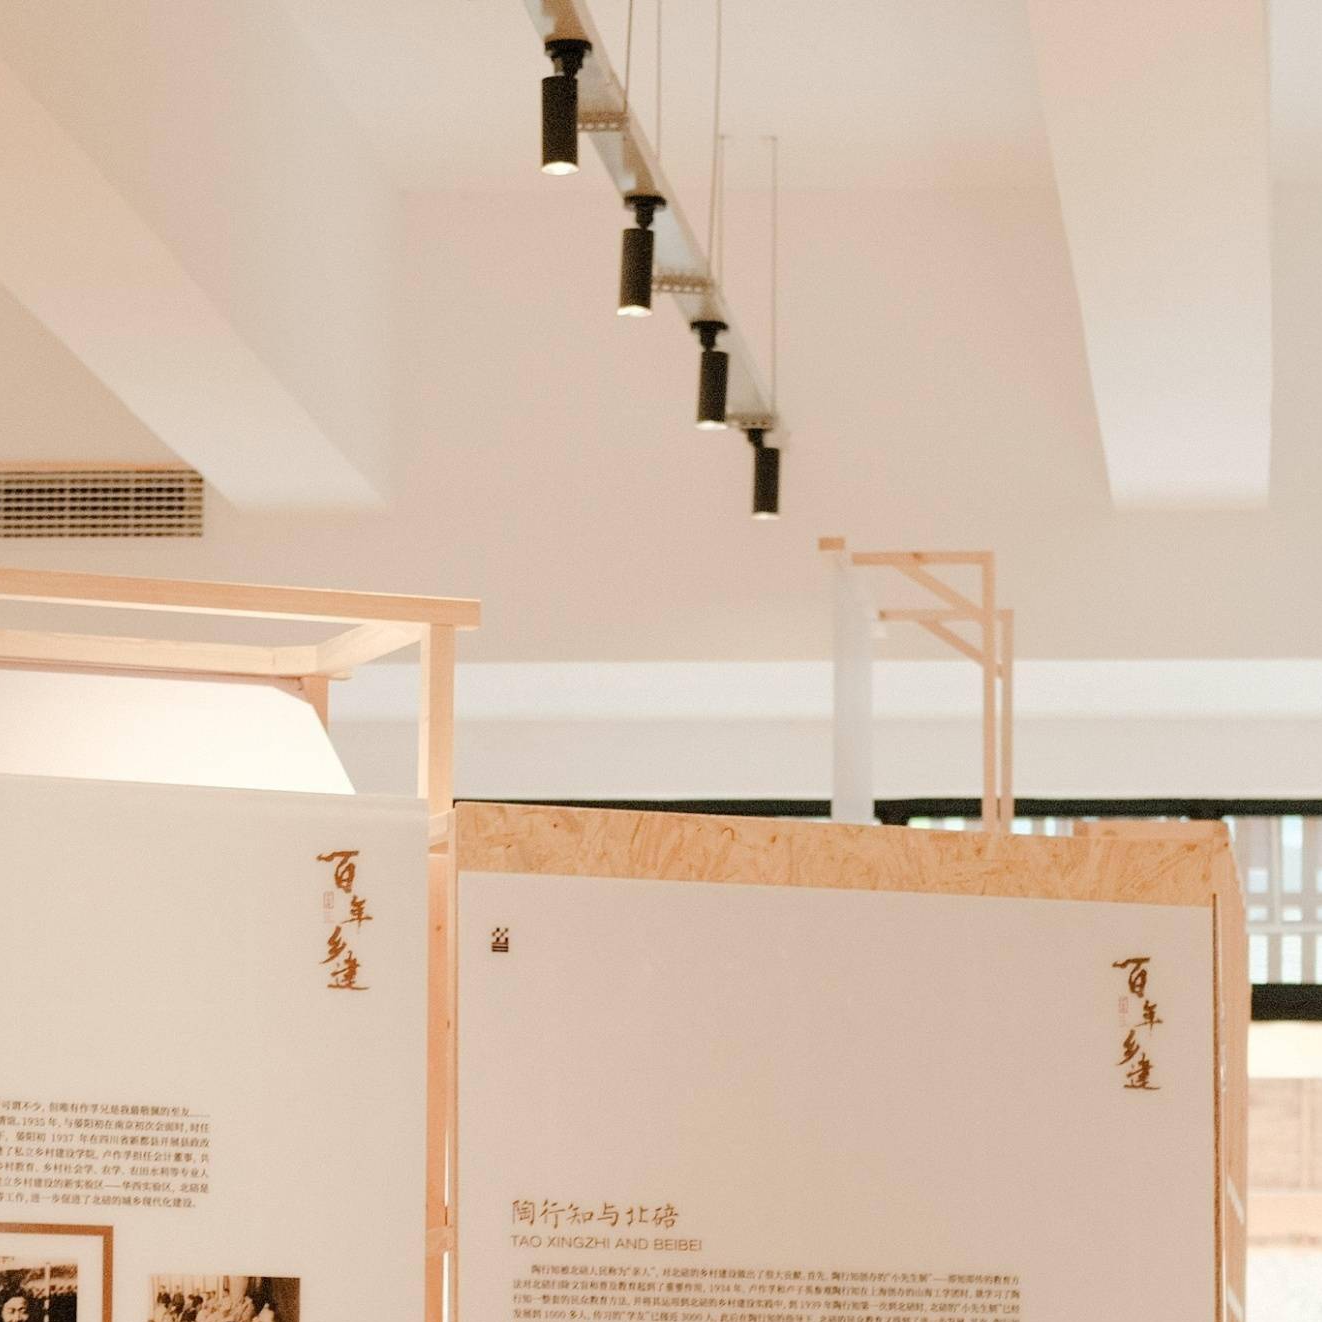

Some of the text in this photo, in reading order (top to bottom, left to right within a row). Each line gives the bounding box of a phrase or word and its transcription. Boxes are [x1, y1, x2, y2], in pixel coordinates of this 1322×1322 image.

[316, 850, 373, 990] 百年乡建
[1112, 957, 1164, 1090] 百年乡建
[511, 1198, 679, 1229] 陶行知与北碚
[511, 1234, 703, 1251] TAO XINGZHI AND BEIBEI
